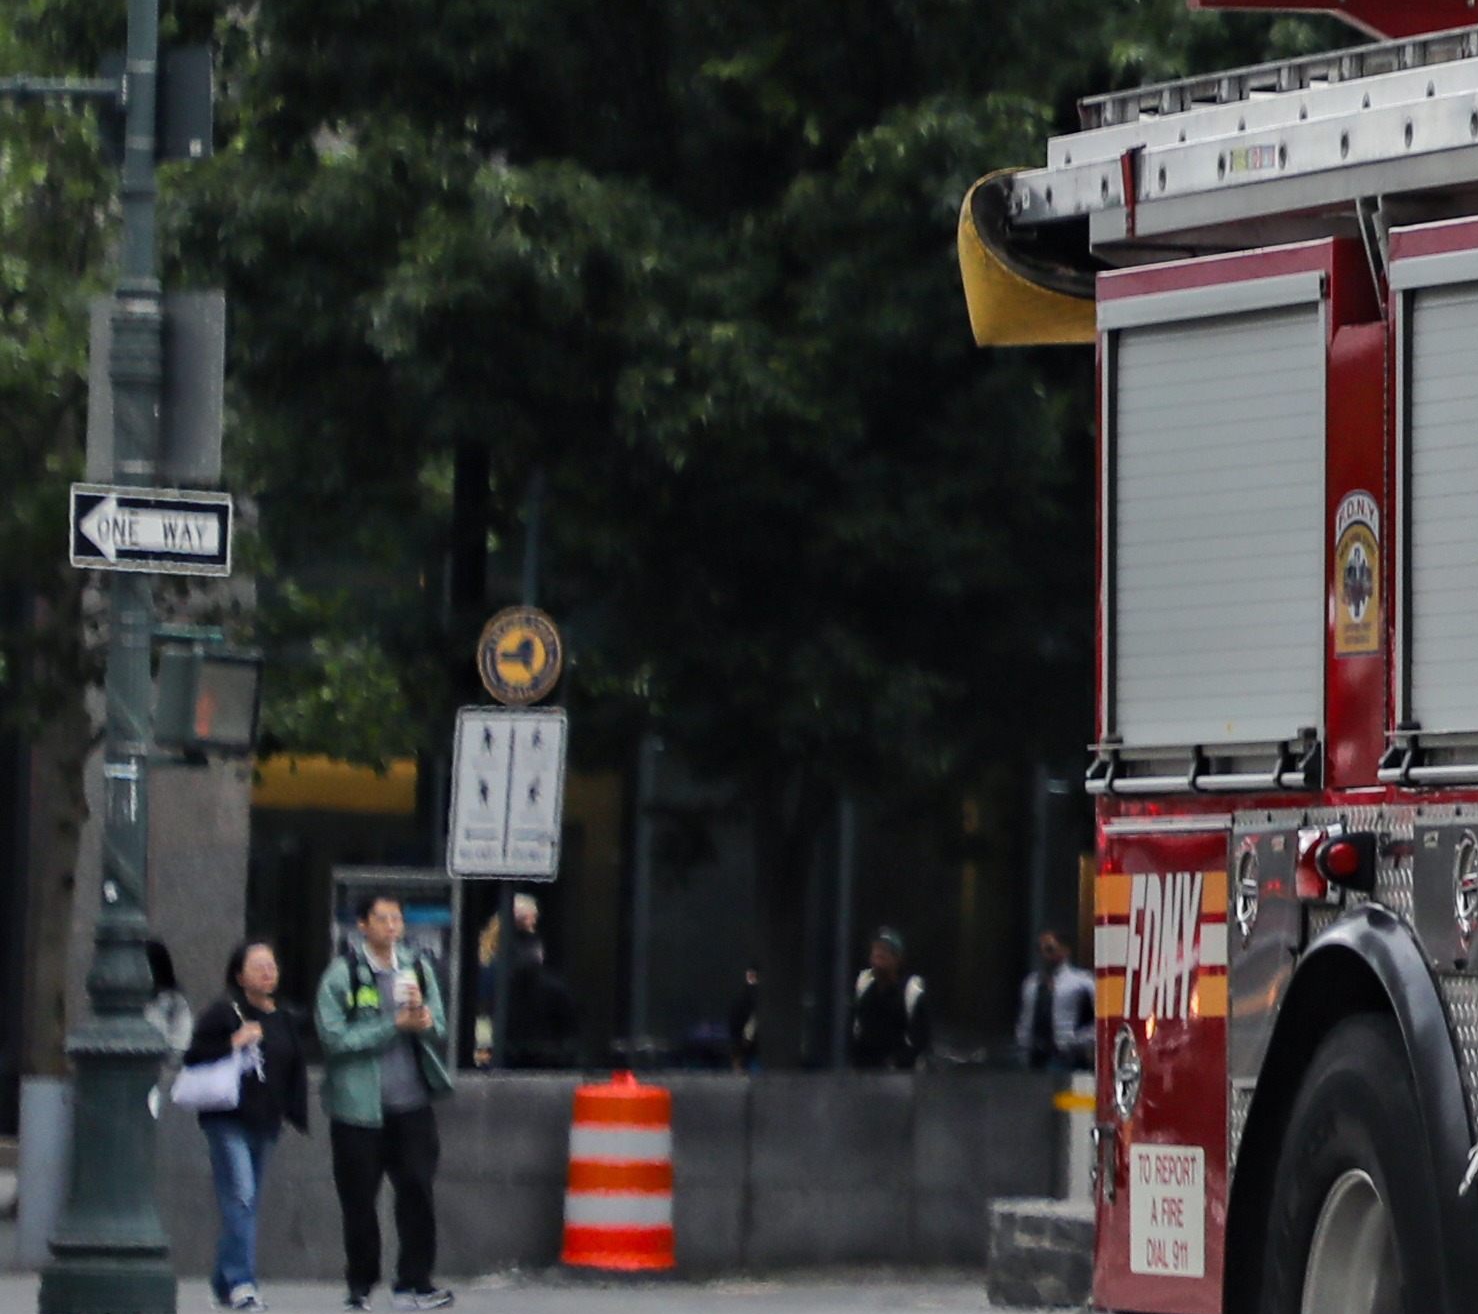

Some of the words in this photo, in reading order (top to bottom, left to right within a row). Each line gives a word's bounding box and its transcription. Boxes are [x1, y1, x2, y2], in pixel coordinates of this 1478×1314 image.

[97, 509, 139, 547] ONE
[162, 513, 207, 551] WAY
[1123, 871, 1203, 1021] FDNY
[1138, 1154, 1151, 1184] TO
[1155, 1154, 1196, 1186] REPORT
[1151, 1196, 1158, 1227] A
[1161, 1197, 1184, 1228] FIRE
[1146, 1237, 1169, 1268] DIAL
[1173, 1239, 1189, 1271] 911
